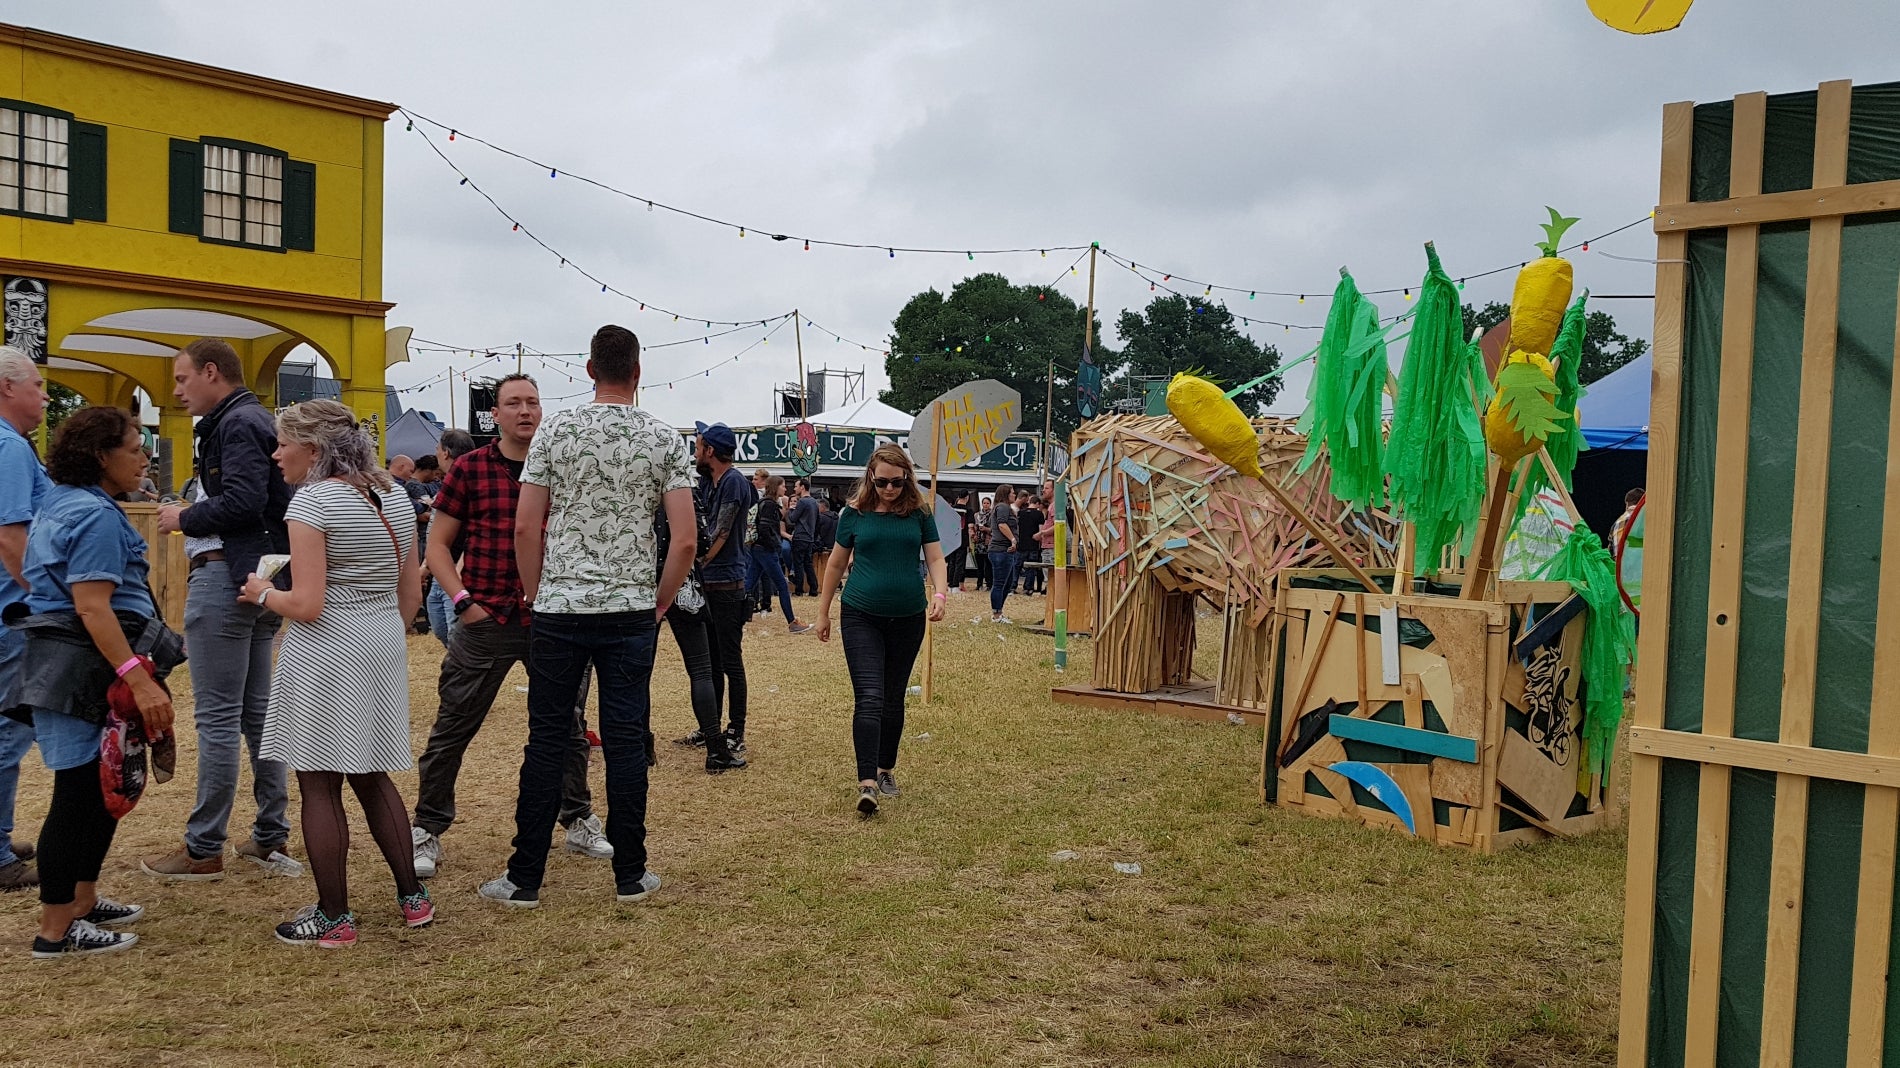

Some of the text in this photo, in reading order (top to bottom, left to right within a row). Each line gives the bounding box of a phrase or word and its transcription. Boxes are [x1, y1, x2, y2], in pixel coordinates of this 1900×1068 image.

[943, 393, 975, 419] ELE
[944, 401, 1014, 447] PHANT
[946, 427, 1001, 466] ASTIC
